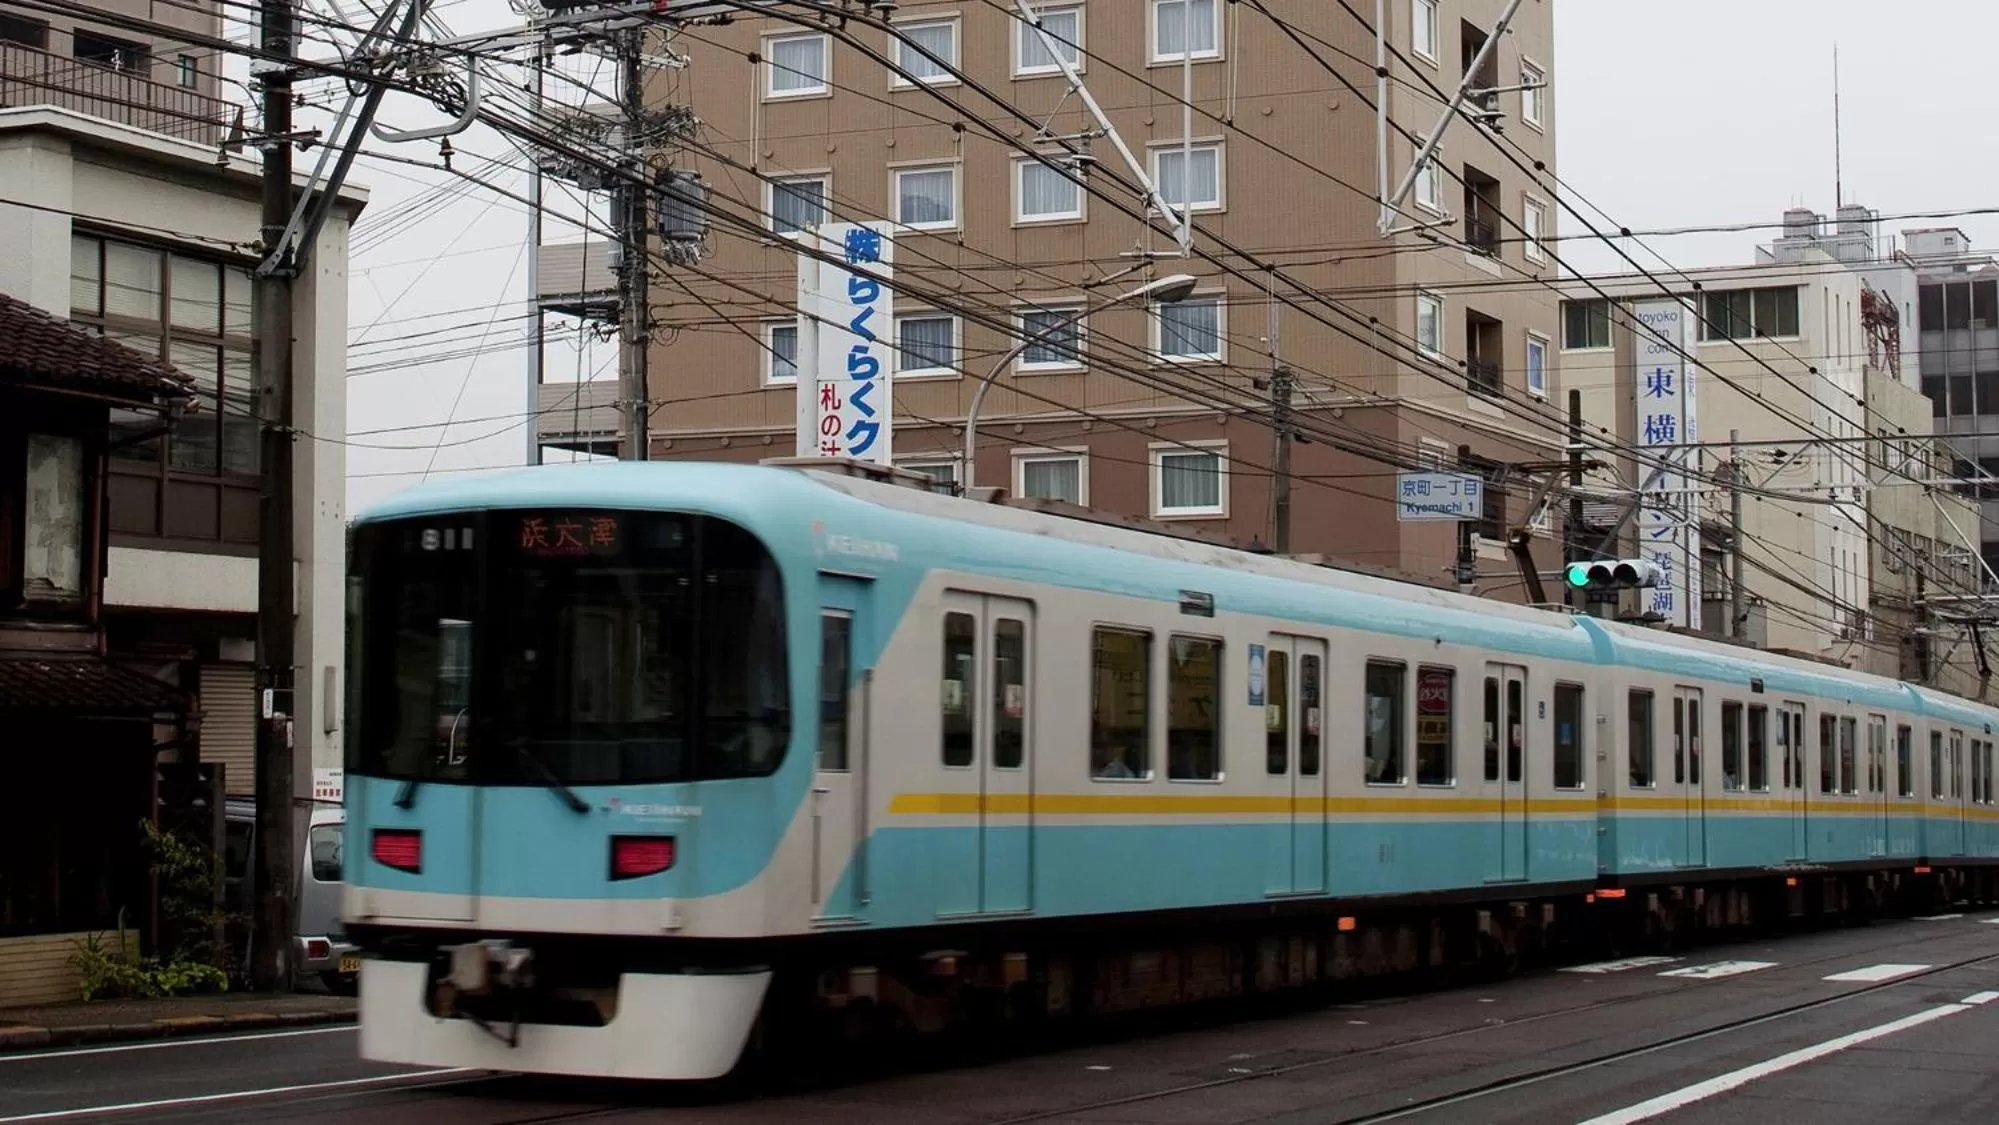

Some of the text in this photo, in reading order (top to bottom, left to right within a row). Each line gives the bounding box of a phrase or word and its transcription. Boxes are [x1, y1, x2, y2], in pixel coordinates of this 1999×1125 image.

[1638, 311, 1678, 325] toyoko
[1402, 479, 1477, 497] 京町一丁目
[1406, 501, 1473, 515] Kyomachi 1
[421, 527, 474, 551] 811
